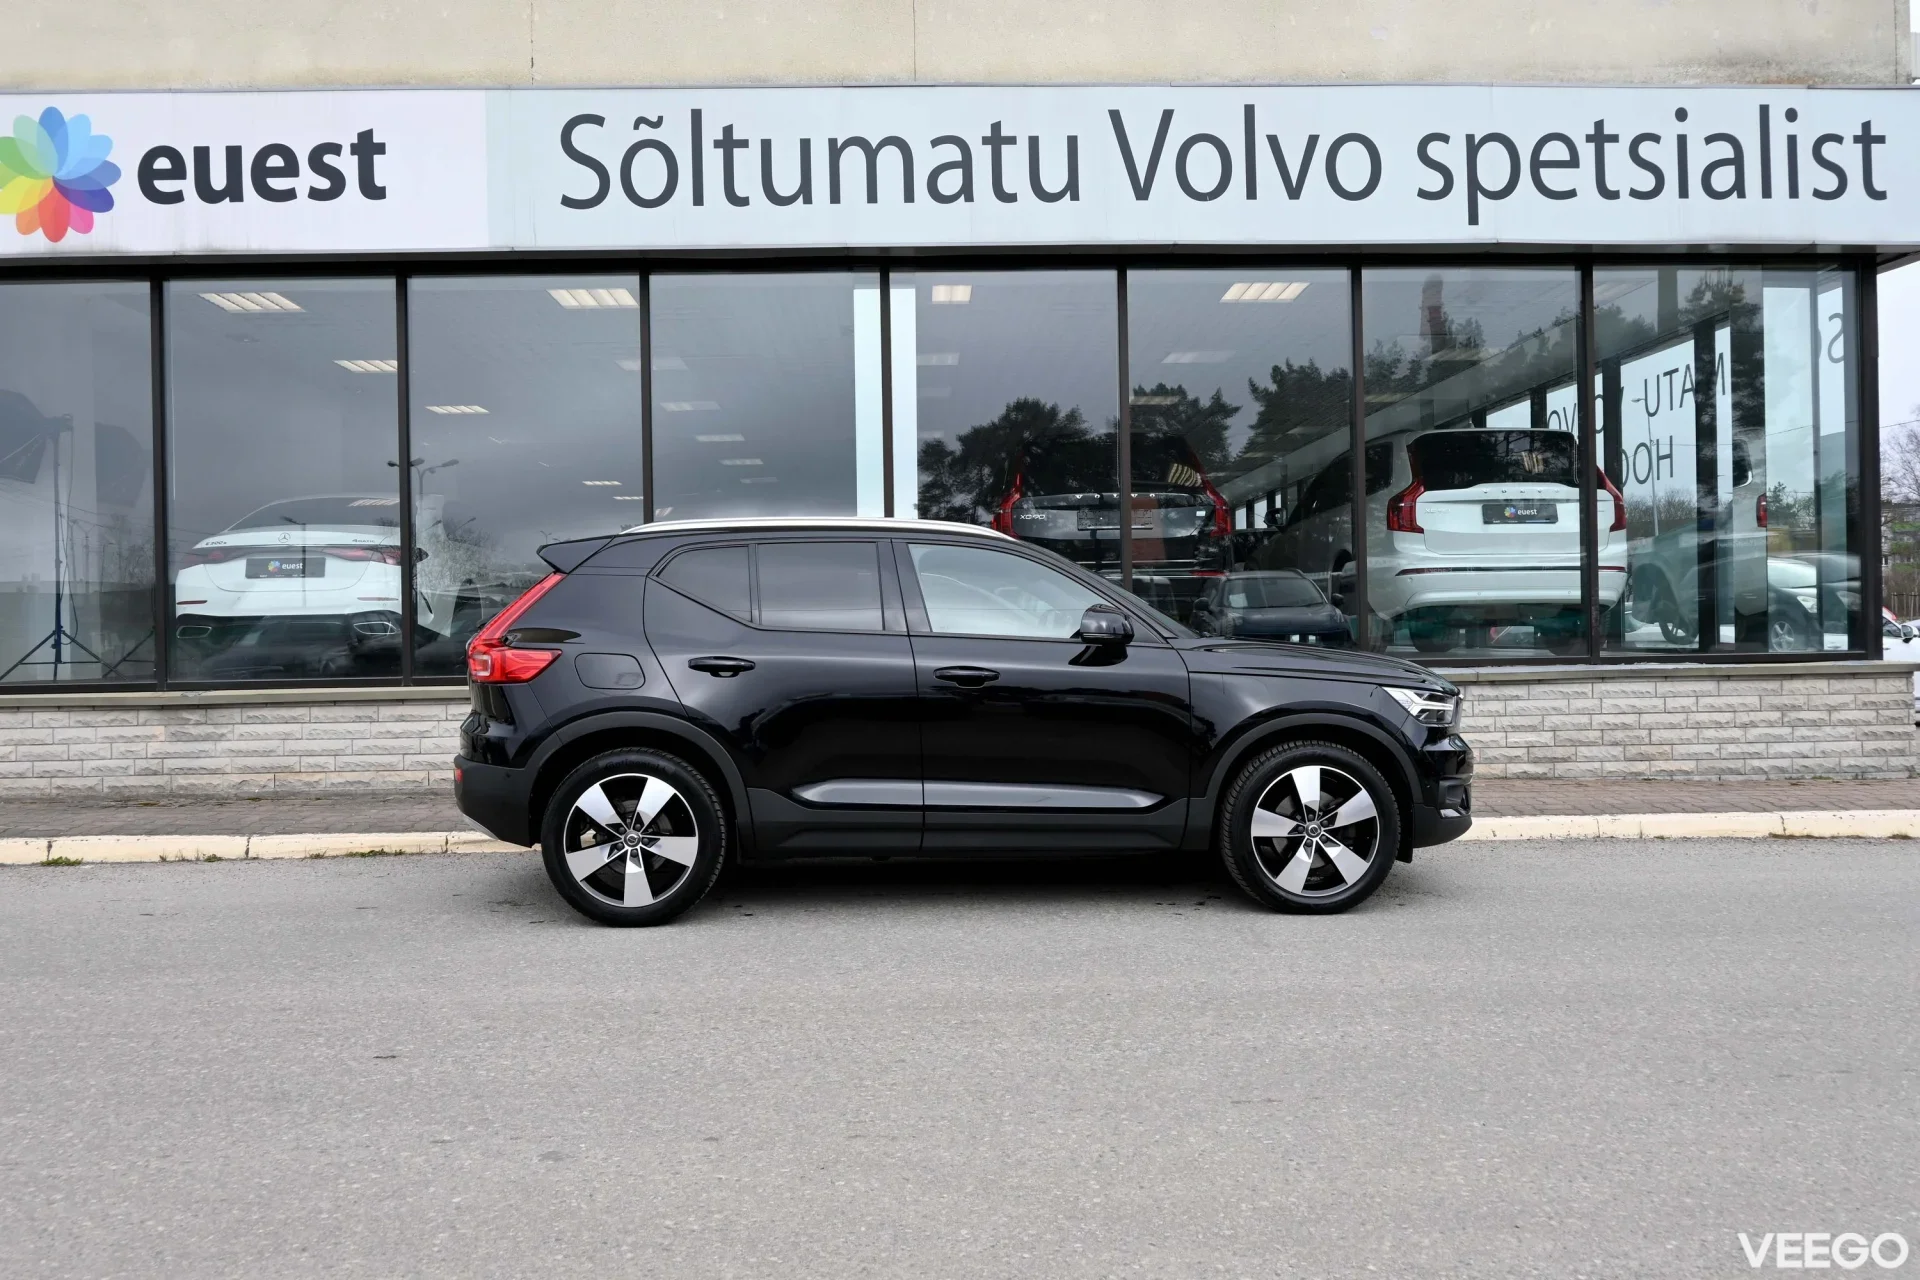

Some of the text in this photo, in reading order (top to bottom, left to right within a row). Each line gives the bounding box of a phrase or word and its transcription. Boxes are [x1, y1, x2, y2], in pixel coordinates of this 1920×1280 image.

[138, 129, 387, 205] euest
[560, 104, 1887, 226] Sõltumatu Volvo spetsialist
[1517, 508, 1538, 516] euest
[281, 561, 304, 570] euest
